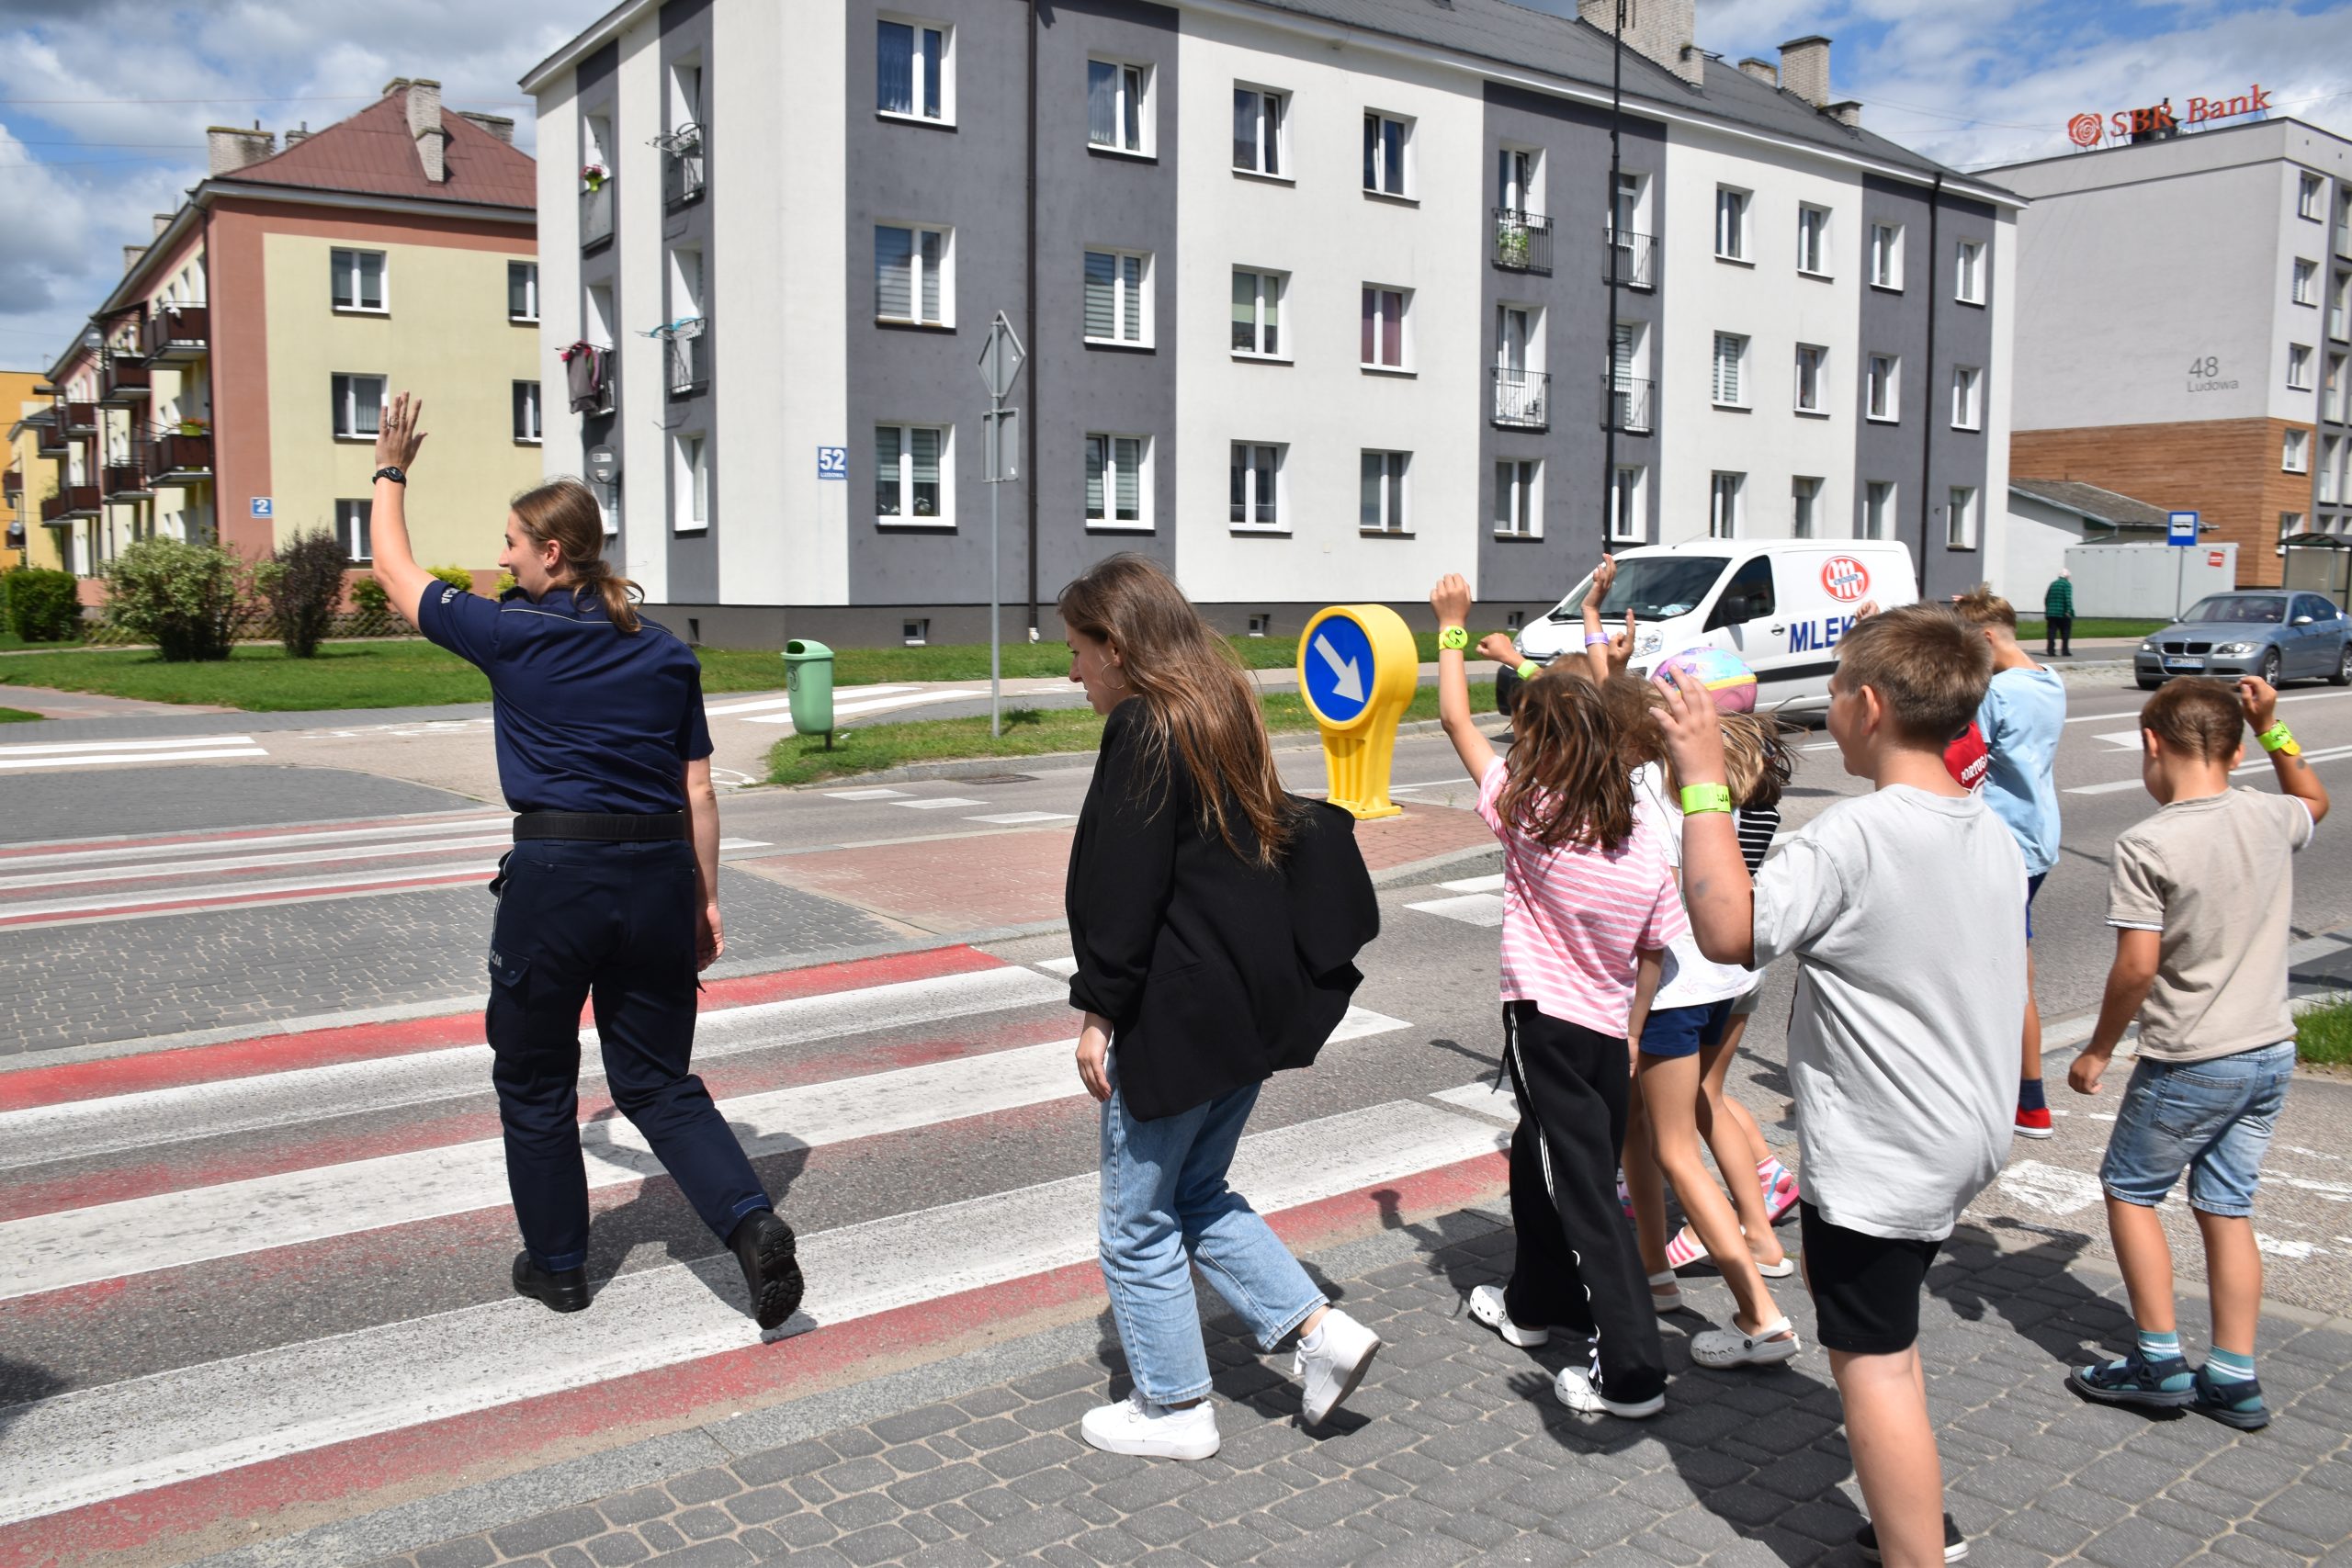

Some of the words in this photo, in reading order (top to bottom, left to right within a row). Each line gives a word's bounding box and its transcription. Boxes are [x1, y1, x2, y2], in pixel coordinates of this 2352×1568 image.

[2110, 103, 2175, 137] SBR
[2187, 84, 2273, 125] Bank
[2188, 355, 2219, 378] 48
[2187, 379, 2239, 392] Ludowa
[819, 448, 846, 470] 52
[254, 499, 270, 513] 2
